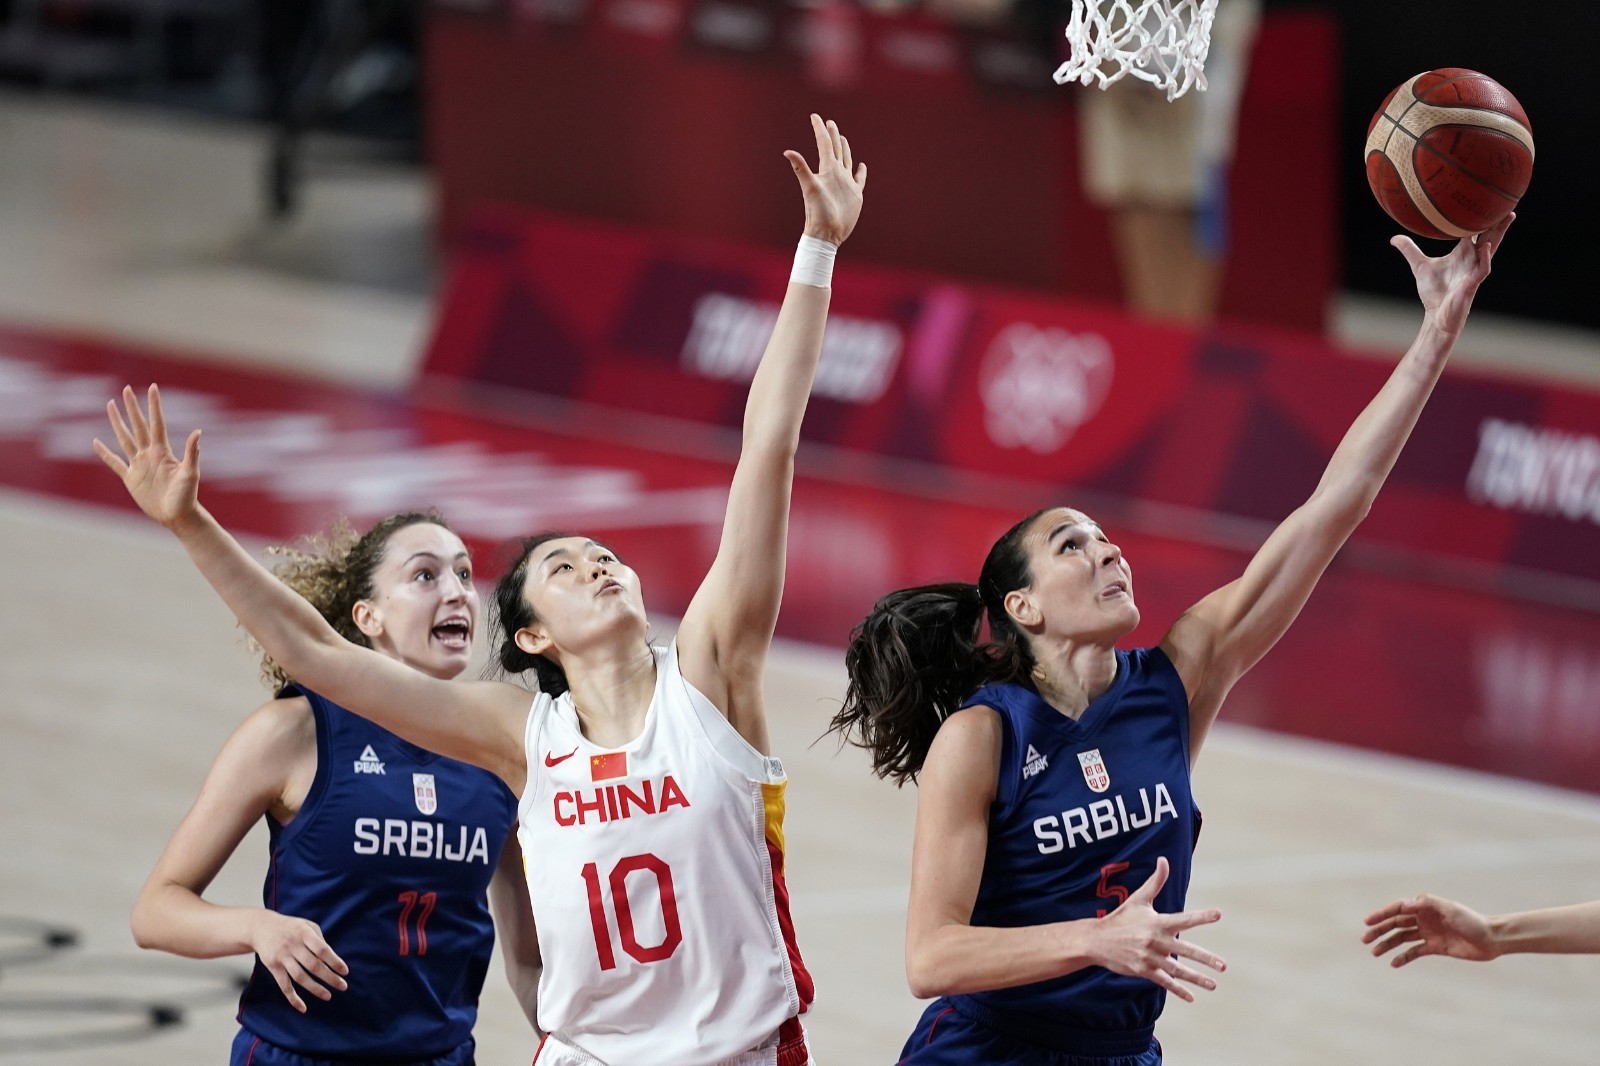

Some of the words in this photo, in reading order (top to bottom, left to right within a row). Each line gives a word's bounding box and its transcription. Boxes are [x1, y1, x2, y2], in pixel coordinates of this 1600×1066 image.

[354, 761, 386, 775] PEAK
[1022, 754, 1048, 780] PEAK
[553, 775, 691, 827] CHINA
[1033, 783, 1178, 855] SRBIJA
[353, 817, 489, 865] SRBIJA
[580, 853, 683, 971] 10
[1095, 860, 1131, 920] 5
[398, 890, 437, 956] 11
